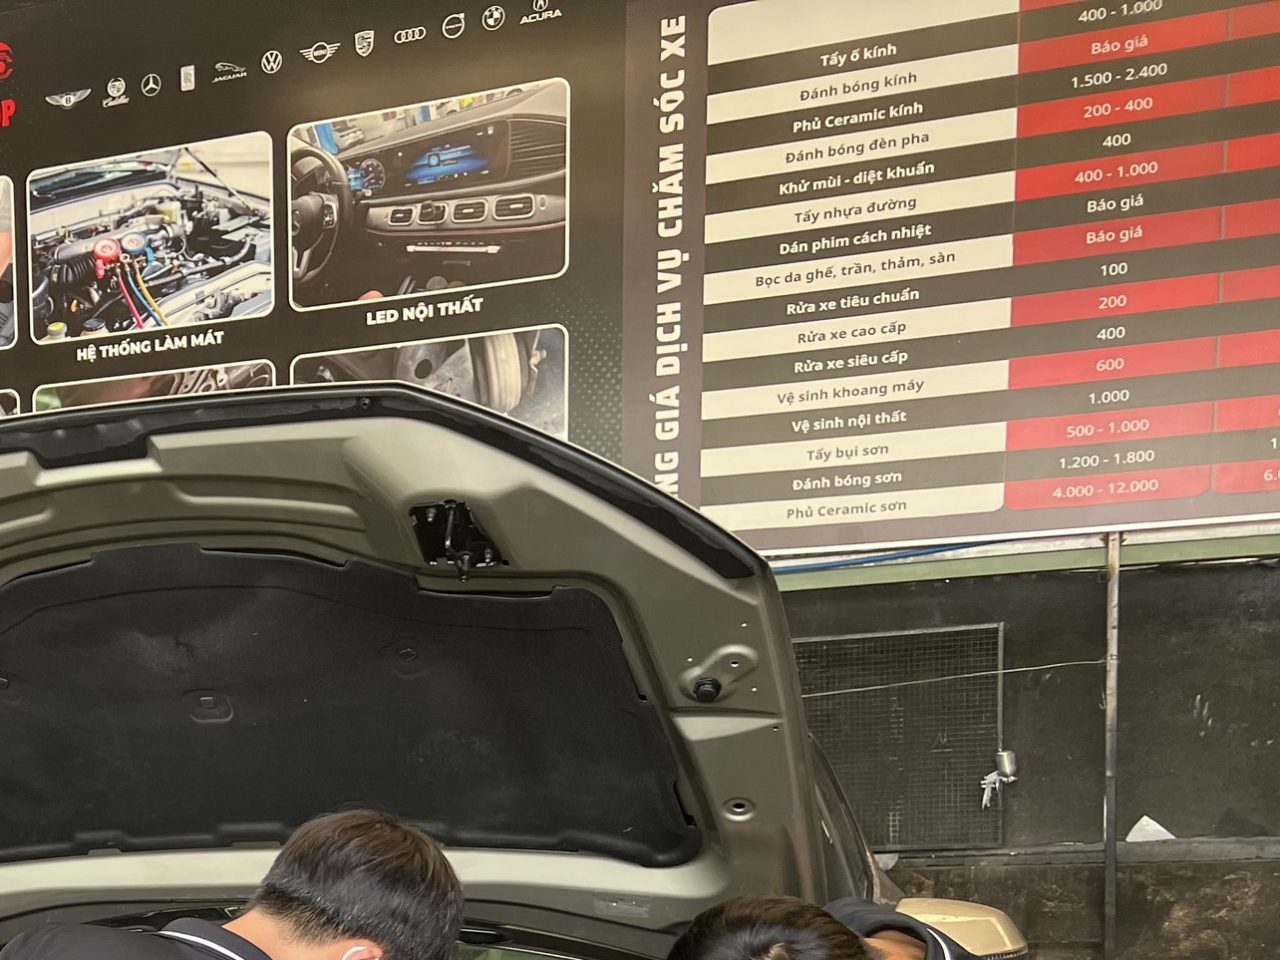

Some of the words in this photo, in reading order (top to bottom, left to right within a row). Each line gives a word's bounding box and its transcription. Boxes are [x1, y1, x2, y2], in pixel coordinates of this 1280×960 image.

[520, 9, 562, 24] ACURA
[1078, 8, 1107, 22] 400
[1121, 0, 1163, 16] 1.000
[660, 15, 686, 61] XE
[1091, 40, 1120, 55] Báo
[1125, 34, 1149, 52] giá
[863, 43, 897, 60] kính
[212, 72, 248, 83] JAGUAR
[800, 85, 838, 101] Đánh
[843, 79, 879, 94] bóng
[884, 72, 917, 87] kính
[1071, 72, 1112, 89] 1.500
[1125, 63, 1168, 81] 2.400
[652, 70, 685, 133] SÓC
[1083, 103, 1111, 119] 200
[1124, 97, 1153, 111] 400
[792, 118, 821, 134] Phủ
[825, 108, 886, 127] Ceramic
[889, 102, 923, 118] kính
[785, 148, 824, 164] Đánh
[828, 142, 864, 157] bóng
[870, 137, 897, 152] đèn
[901, 133, 929, 148] pha
[1102, 133, 1132, 147] 400
[779, 181, 809, 195] Khử
[813, 175, 841, 190] mùi
[853, 170, 883, 185] diệt
[1075, 169, 1103, 183] 400
[1117, 161, 1158, 178] 1.000
[652, 143, 685, 238] CHĂM
[824, 204, 862, 220] nhựa
[867, 198, 917, 214] đường
[1087, 198, 1116, 213] Báo
[1120, 193, 1144, 211] giá
[779, 240, 808, 255] Dán
[812, 236, 849, 253] phim
[853, 229, 887, 244] cách
[892, 223, 932, 240] nhiệt
[1086, 229, 1115, 244] Báo
[1119, 225, 1143, 242] giá
[657, 249, 690, 294] VỤ
[756, 274, 781, 289] Bọc
[785, 271, 802, 283] da
[930, 252, 956, 265] sàn
[1100, 262, 1128, 277] 100
[366, 309, 399, 325] LED
[403, 302, 434, 322] NỘI
[437, 294, 484, 316] THẤT
[787, 301, 816, 315] Rửa
[819, 300, 837, 312] xe
[840, 295, 869, 308] tiêu
[1098, 295, 1127, 310] 200
[656, 302, 688, 377] DỊCH
[798, 330, 826, 344] Rửa
[830, 329, 847, 341] xe
[851, 326, 876, 338] cao
[880, 320, 907, 335] cấp
[1096, 326, 1126, 340] 400
[77, 346, 96, 362] HỆ
[99, 339, 151, 358] THỐNG
[155, 336, 187, 353] LÀM
[190, 330, 225, 348] MÁT
[794, 359, 823, 374] Rửa
[826, 358, 844, 370] xe
[848, 354, 878, 367] siêu
[881, 350, 908, 365] cấp
[1096, 358, 1125, 372] 600
[777, 393, 794, 405] Vệ
[798, 389, 828, 402] sinh
[833, 384, 888, 399] khoang
[893, 379, 924, 393] máy
[1088, 389, 1130, 405] 1.000
[649, 385, 680, 441] GIÁ
[792, 420, 810, 434] Vệ
[813, 416, 844, 431] sinh
[848, 414, 871, 429] nội
[875, 410, 907, 424] thất
[1066, 424, 1095, 438] 500
[1108, 419, 1150, 434] 1.000
[835, 447, 858, 460] bụi
[862, 445, 889, 457] sơn
[1059, 455, 1100, 469] 1.200
[1114, 450, 1155, 465] 1.800
[792, 477, 830, 491] Đánh
[834, 474, 871, 488] bóng
[874, 472, 902, 484] sơn
[1052, 485, 1094, 499] 4.000
[1108, 479, 1159, 495] 12.000
[786, 506, 814, 519] Phủ
[817, 503, 877, 517] Ceramic
[880, 501, 907, 513] sơn
